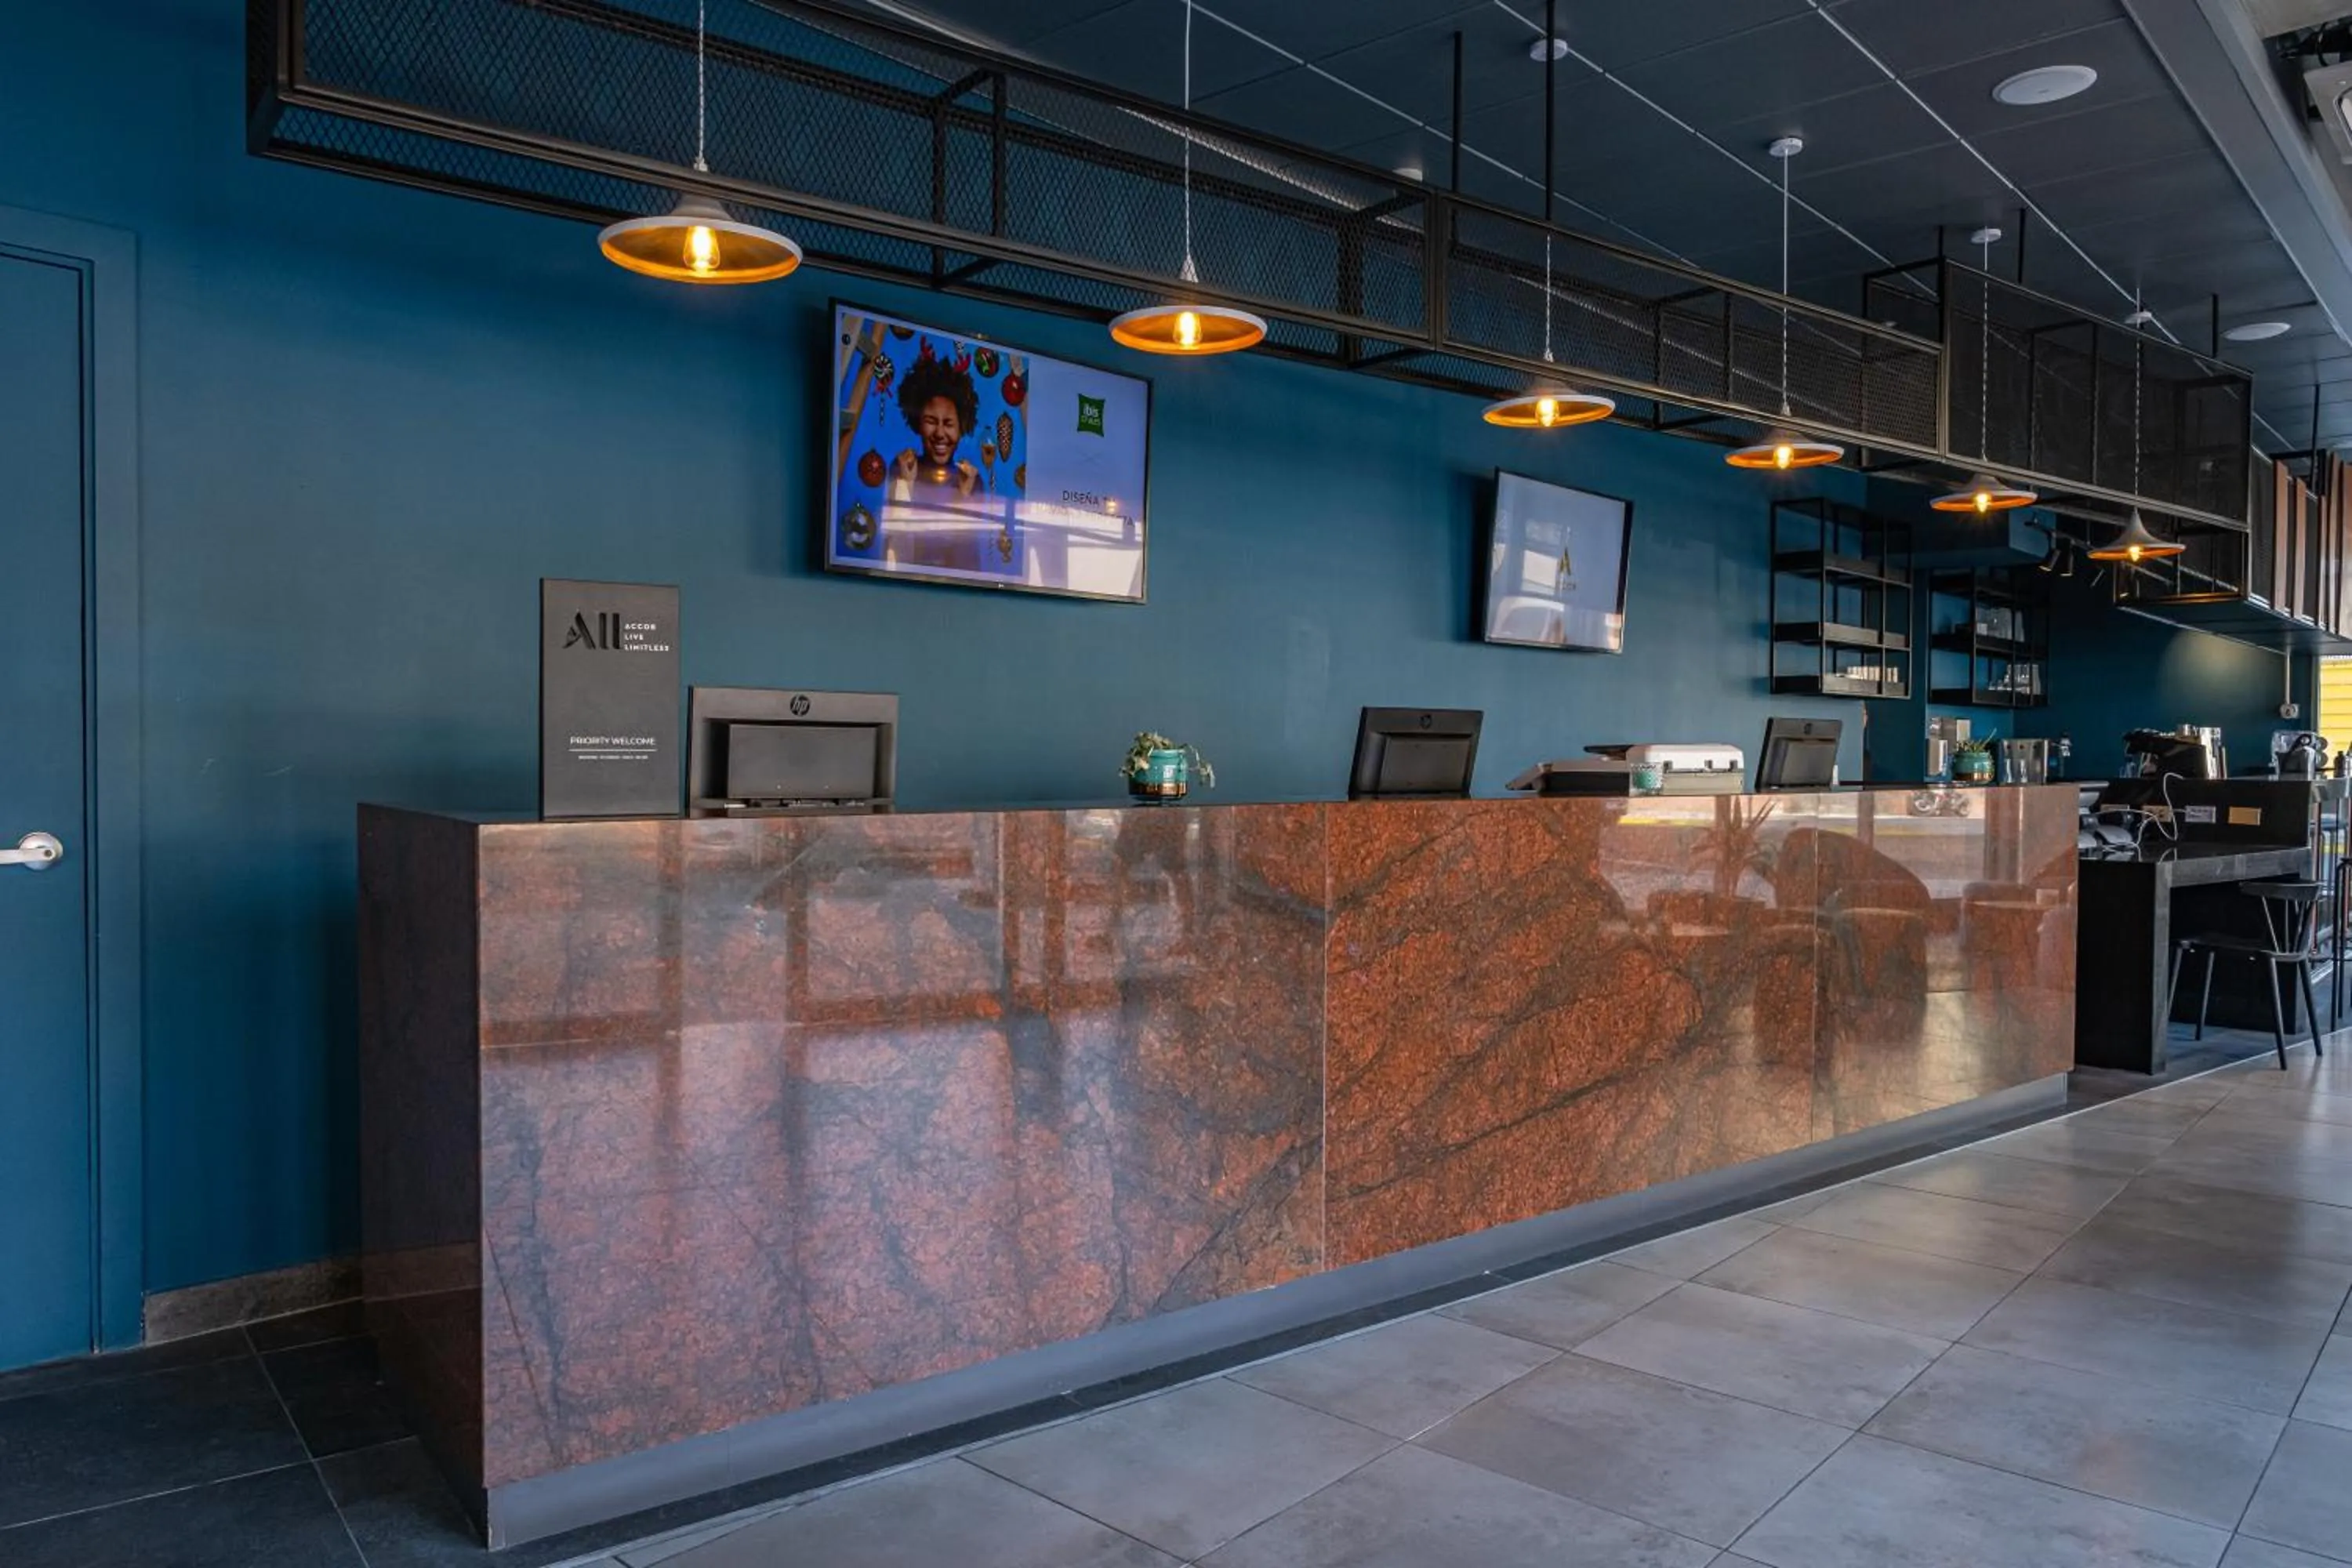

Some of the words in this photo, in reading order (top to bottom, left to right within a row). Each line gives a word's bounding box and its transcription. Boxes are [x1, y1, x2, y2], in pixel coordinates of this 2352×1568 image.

[790, 695, 810, 717] hp
[570, 736, 610, 745] PRIORITY
[611, 737, 657, 746] WELCOME
